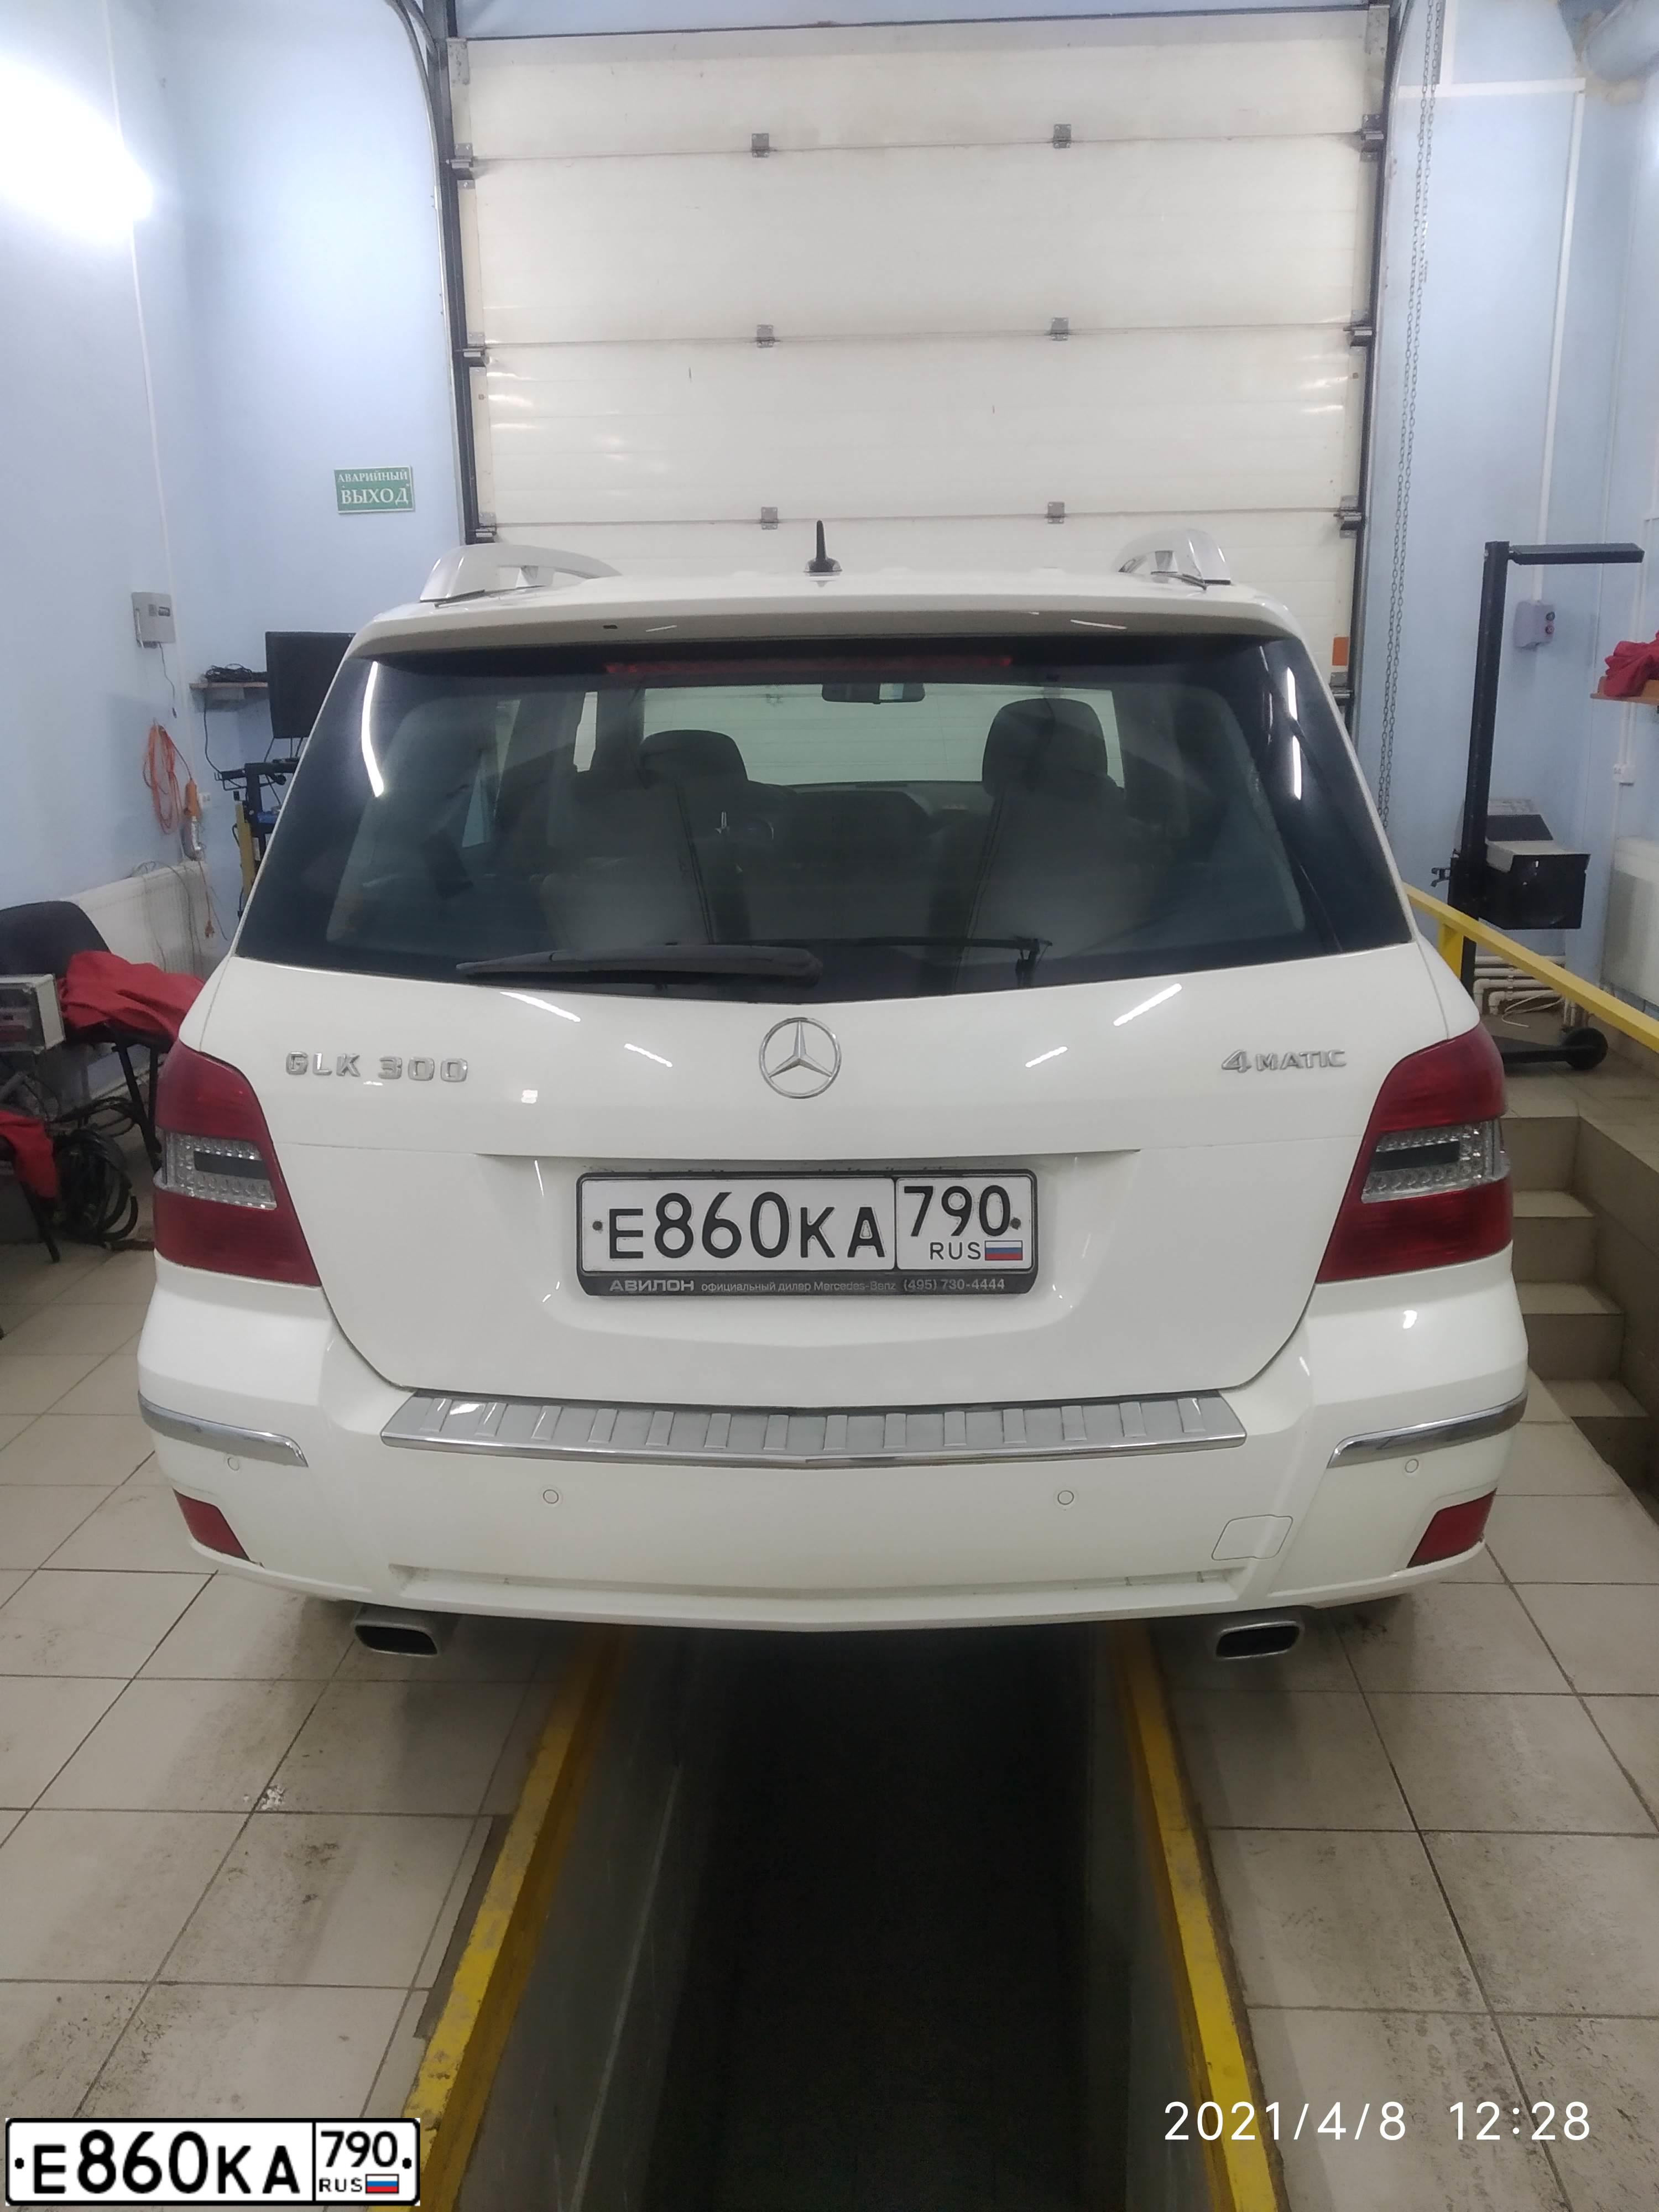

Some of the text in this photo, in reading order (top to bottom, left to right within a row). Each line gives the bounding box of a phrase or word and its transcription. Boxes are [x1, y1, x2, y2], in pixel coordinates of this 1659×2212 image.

[337, 469, 408, 482] АВАРИЙНЫЙ
[341, 488, 409, 505] ВЫХОД
[286, 1051, 468, 1082] GLK 300
[904, 1185, 1010, 1237] 790
[930, 1242, 980, 1260] RUS
[609, 1279, 1005, 1292] АВИЛОН официальный дилер Mercedes-Benz (495) 730-4444
